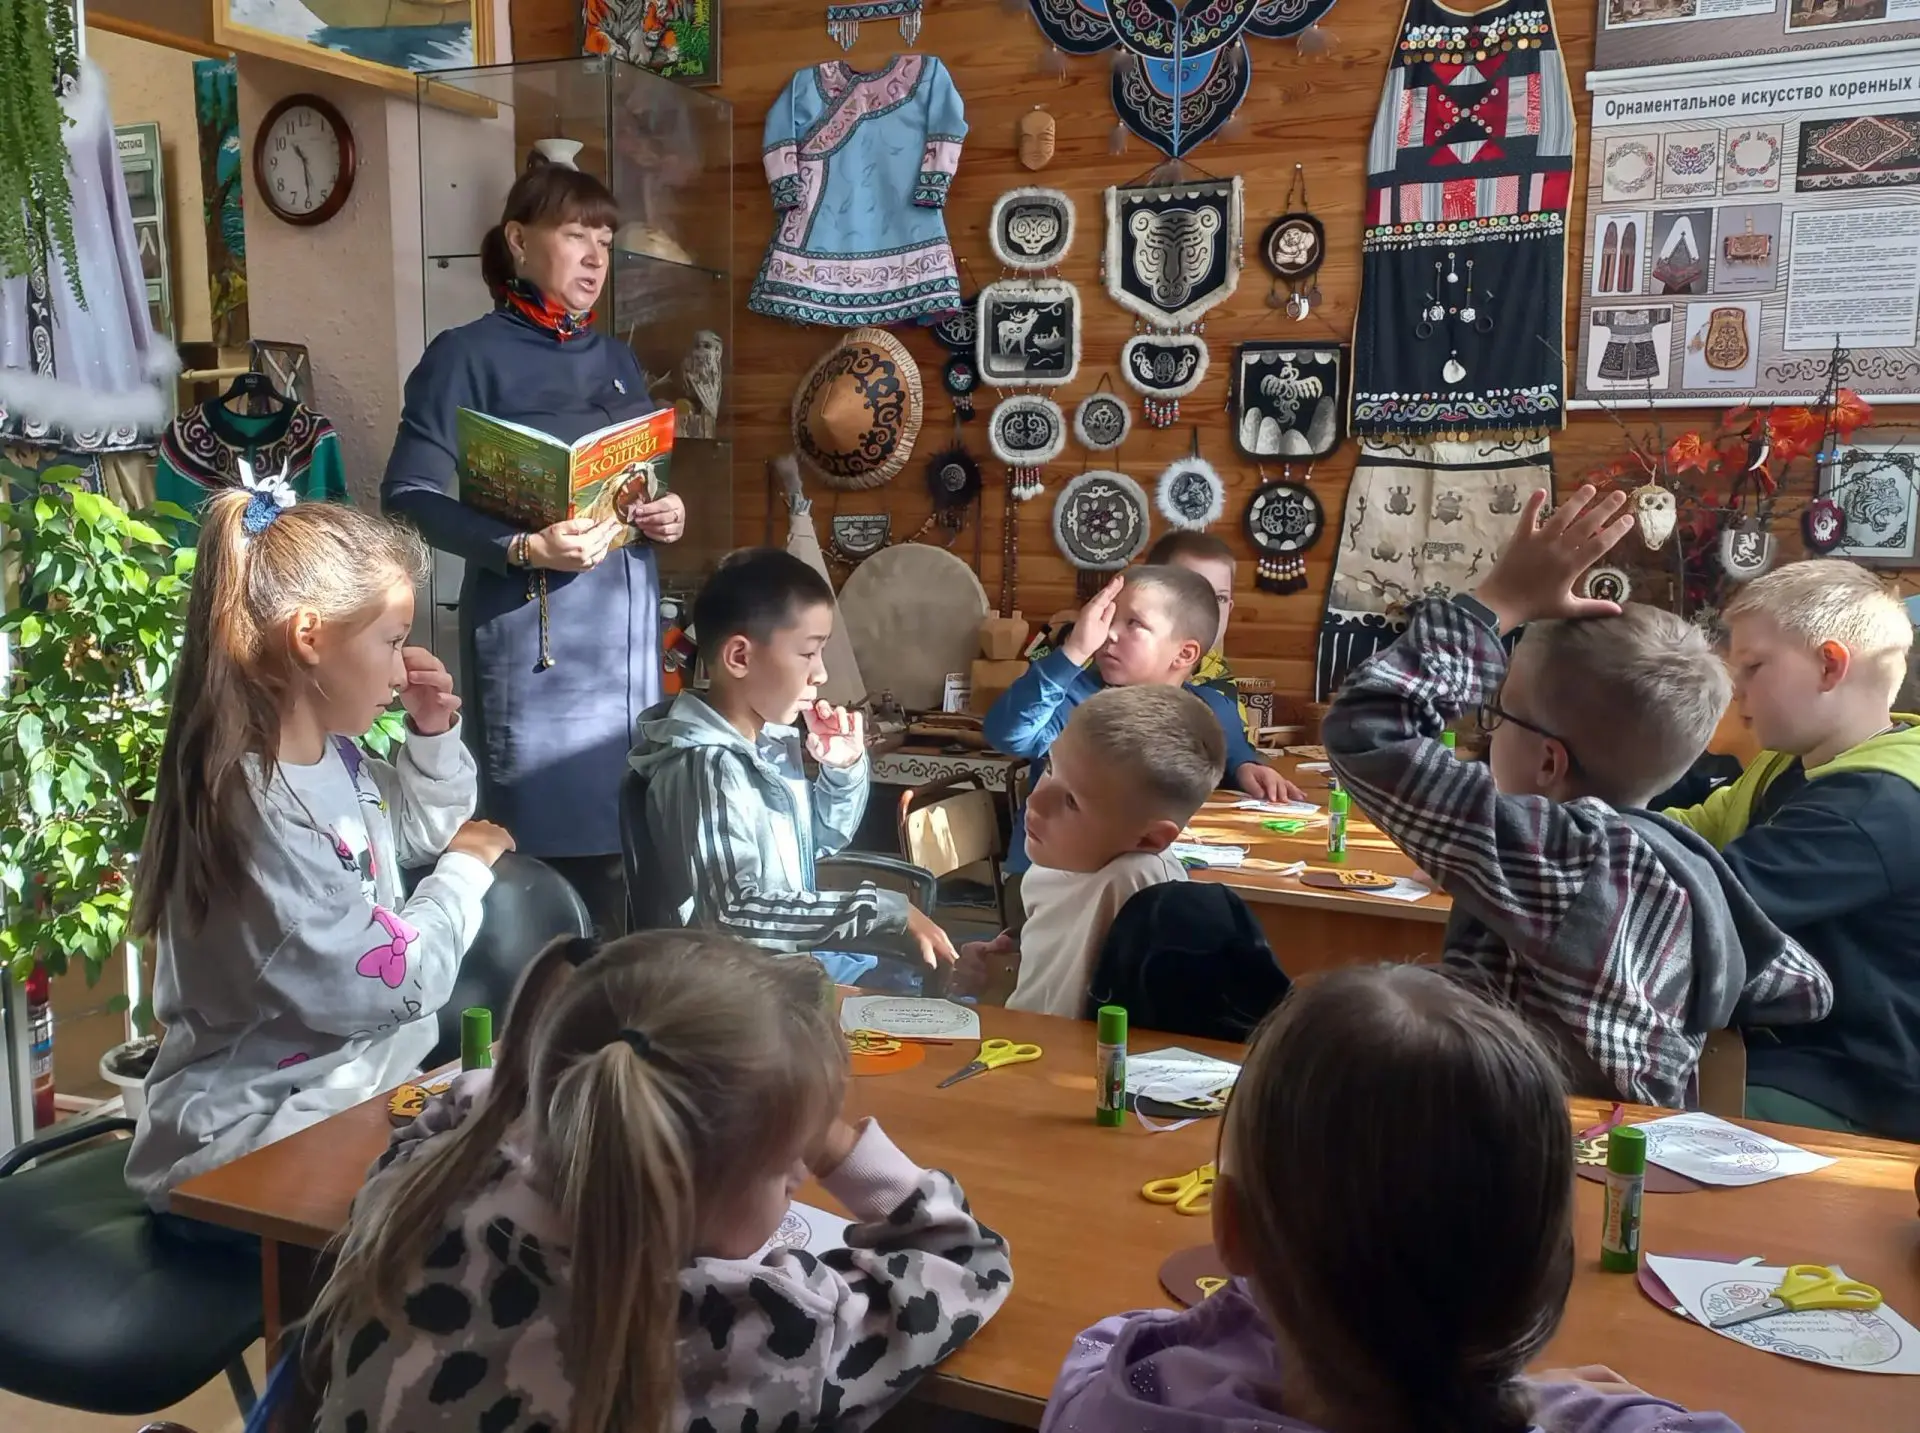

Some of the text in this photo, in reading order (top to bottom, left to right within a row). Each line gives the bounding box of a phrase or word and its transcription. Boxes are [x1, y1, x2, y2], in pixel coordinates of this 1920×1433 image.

[1605, 93, 1736, 119] Орнаментальное
[1741, 85, 1823, 107] искусство
[1829, 77, 1912, 99] коренных
[298, 111, 311, 128] 12
[320, 119, 325, 132] 1
[286, 121, 295, 135] 11
[275, 136, 287, 151] 10
[270, 158, 278, 171] 9
[277, 178, 285, 192] 8
[290, 191, 298, 205] 7
[304, 196, 312, 209] 6
[603, 431, 650, 457] БОЛЬШИЕ
[588, 436, 659, 478] КОШКИ
